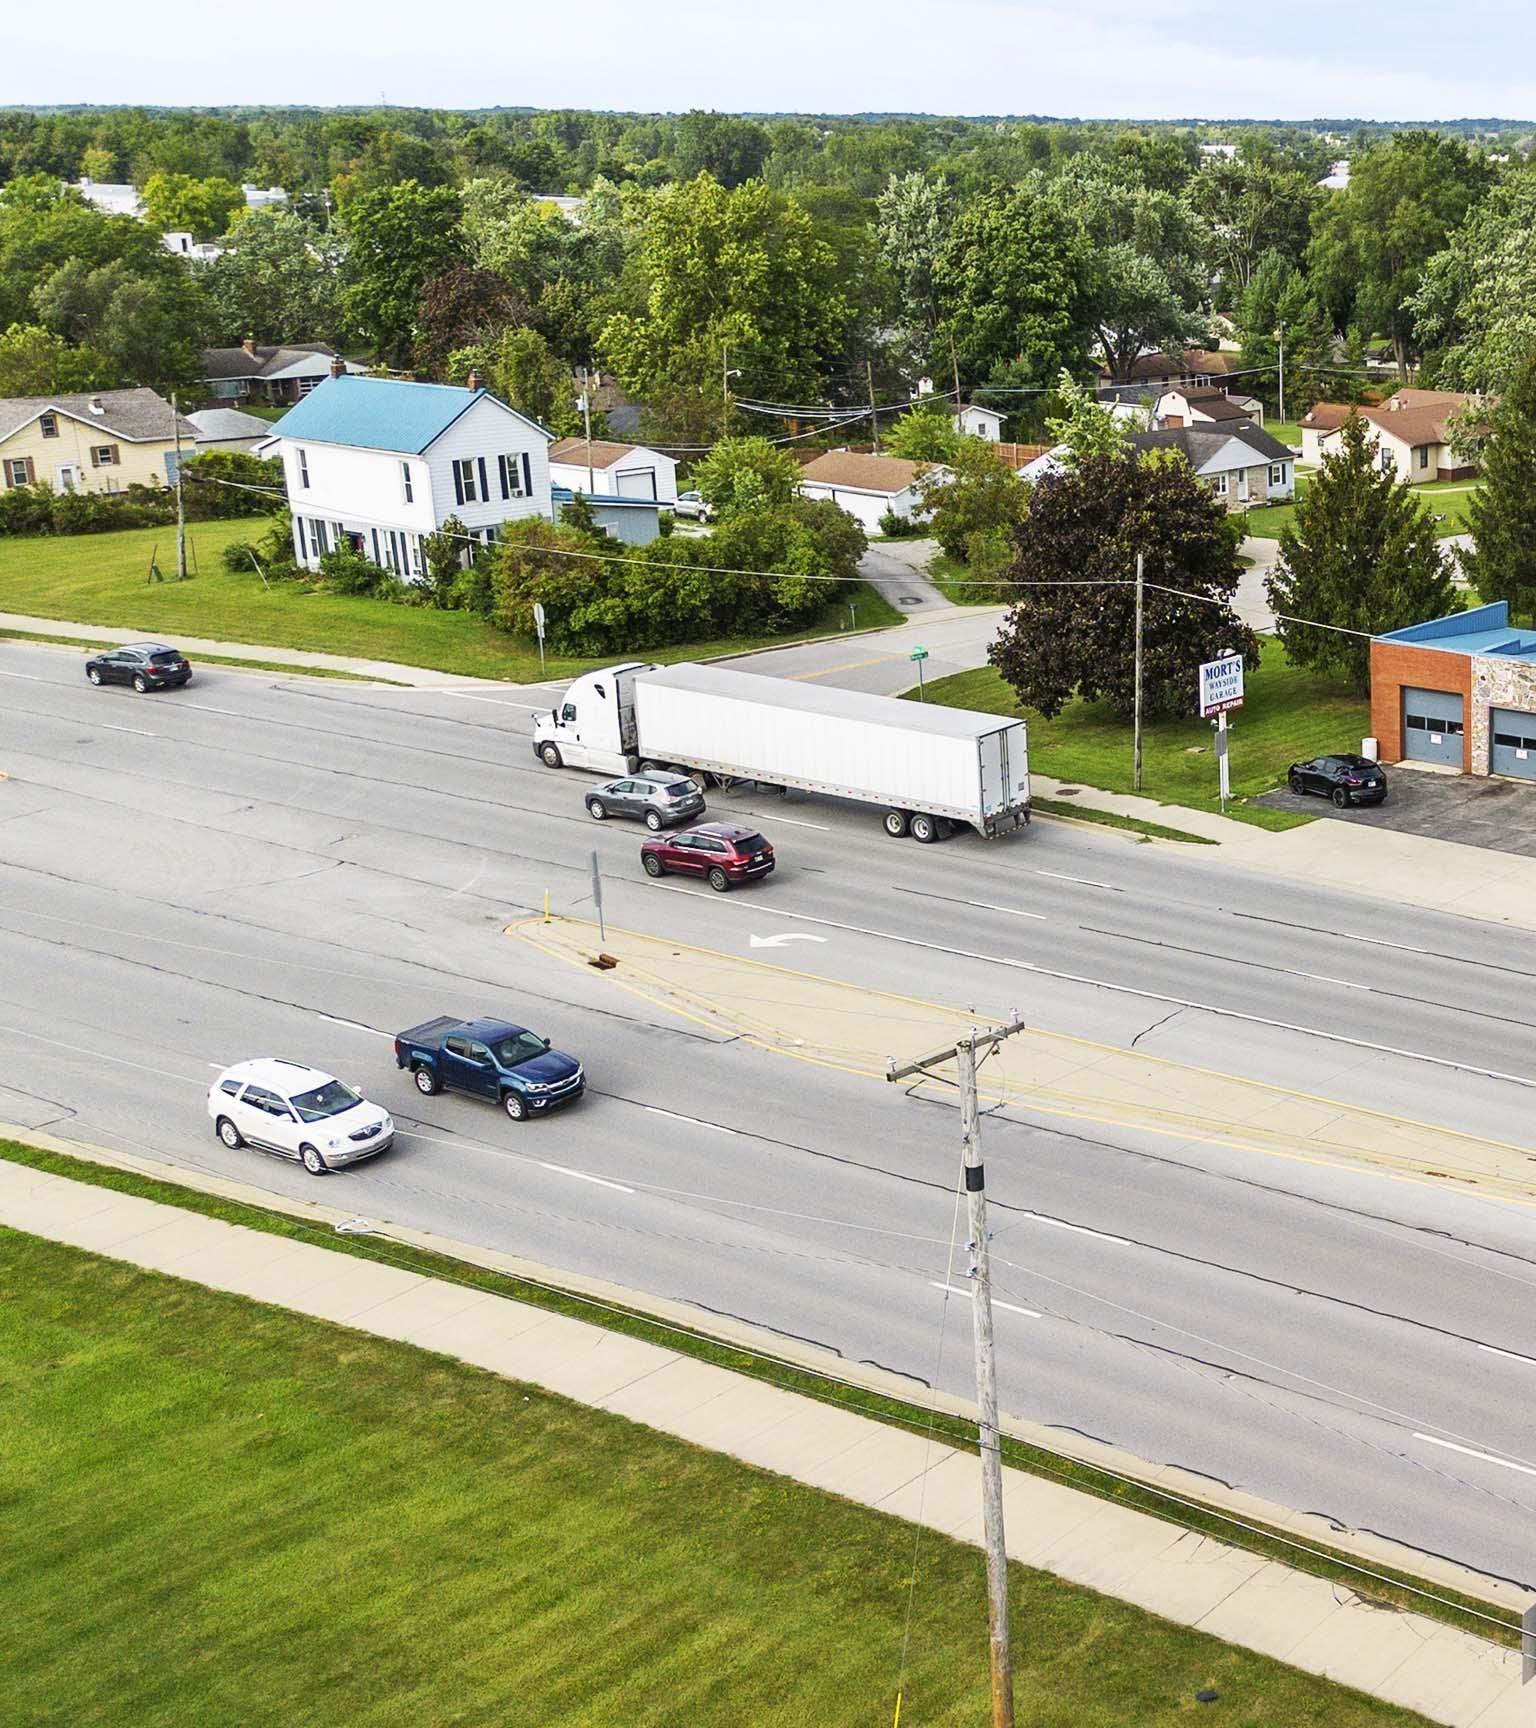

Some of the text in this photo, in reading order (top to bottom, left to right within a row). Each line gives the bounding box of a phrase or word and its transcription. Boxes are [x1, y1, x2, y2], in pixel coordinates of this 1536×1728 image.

[1205, 660, 1241, 680] MORT'S
[1209, 676, 1238, 689] WAYSIDE
[1209, 687, 1238, 702] GARAGE
[1206, 698, 1244, 715] AUTO REPAIR
